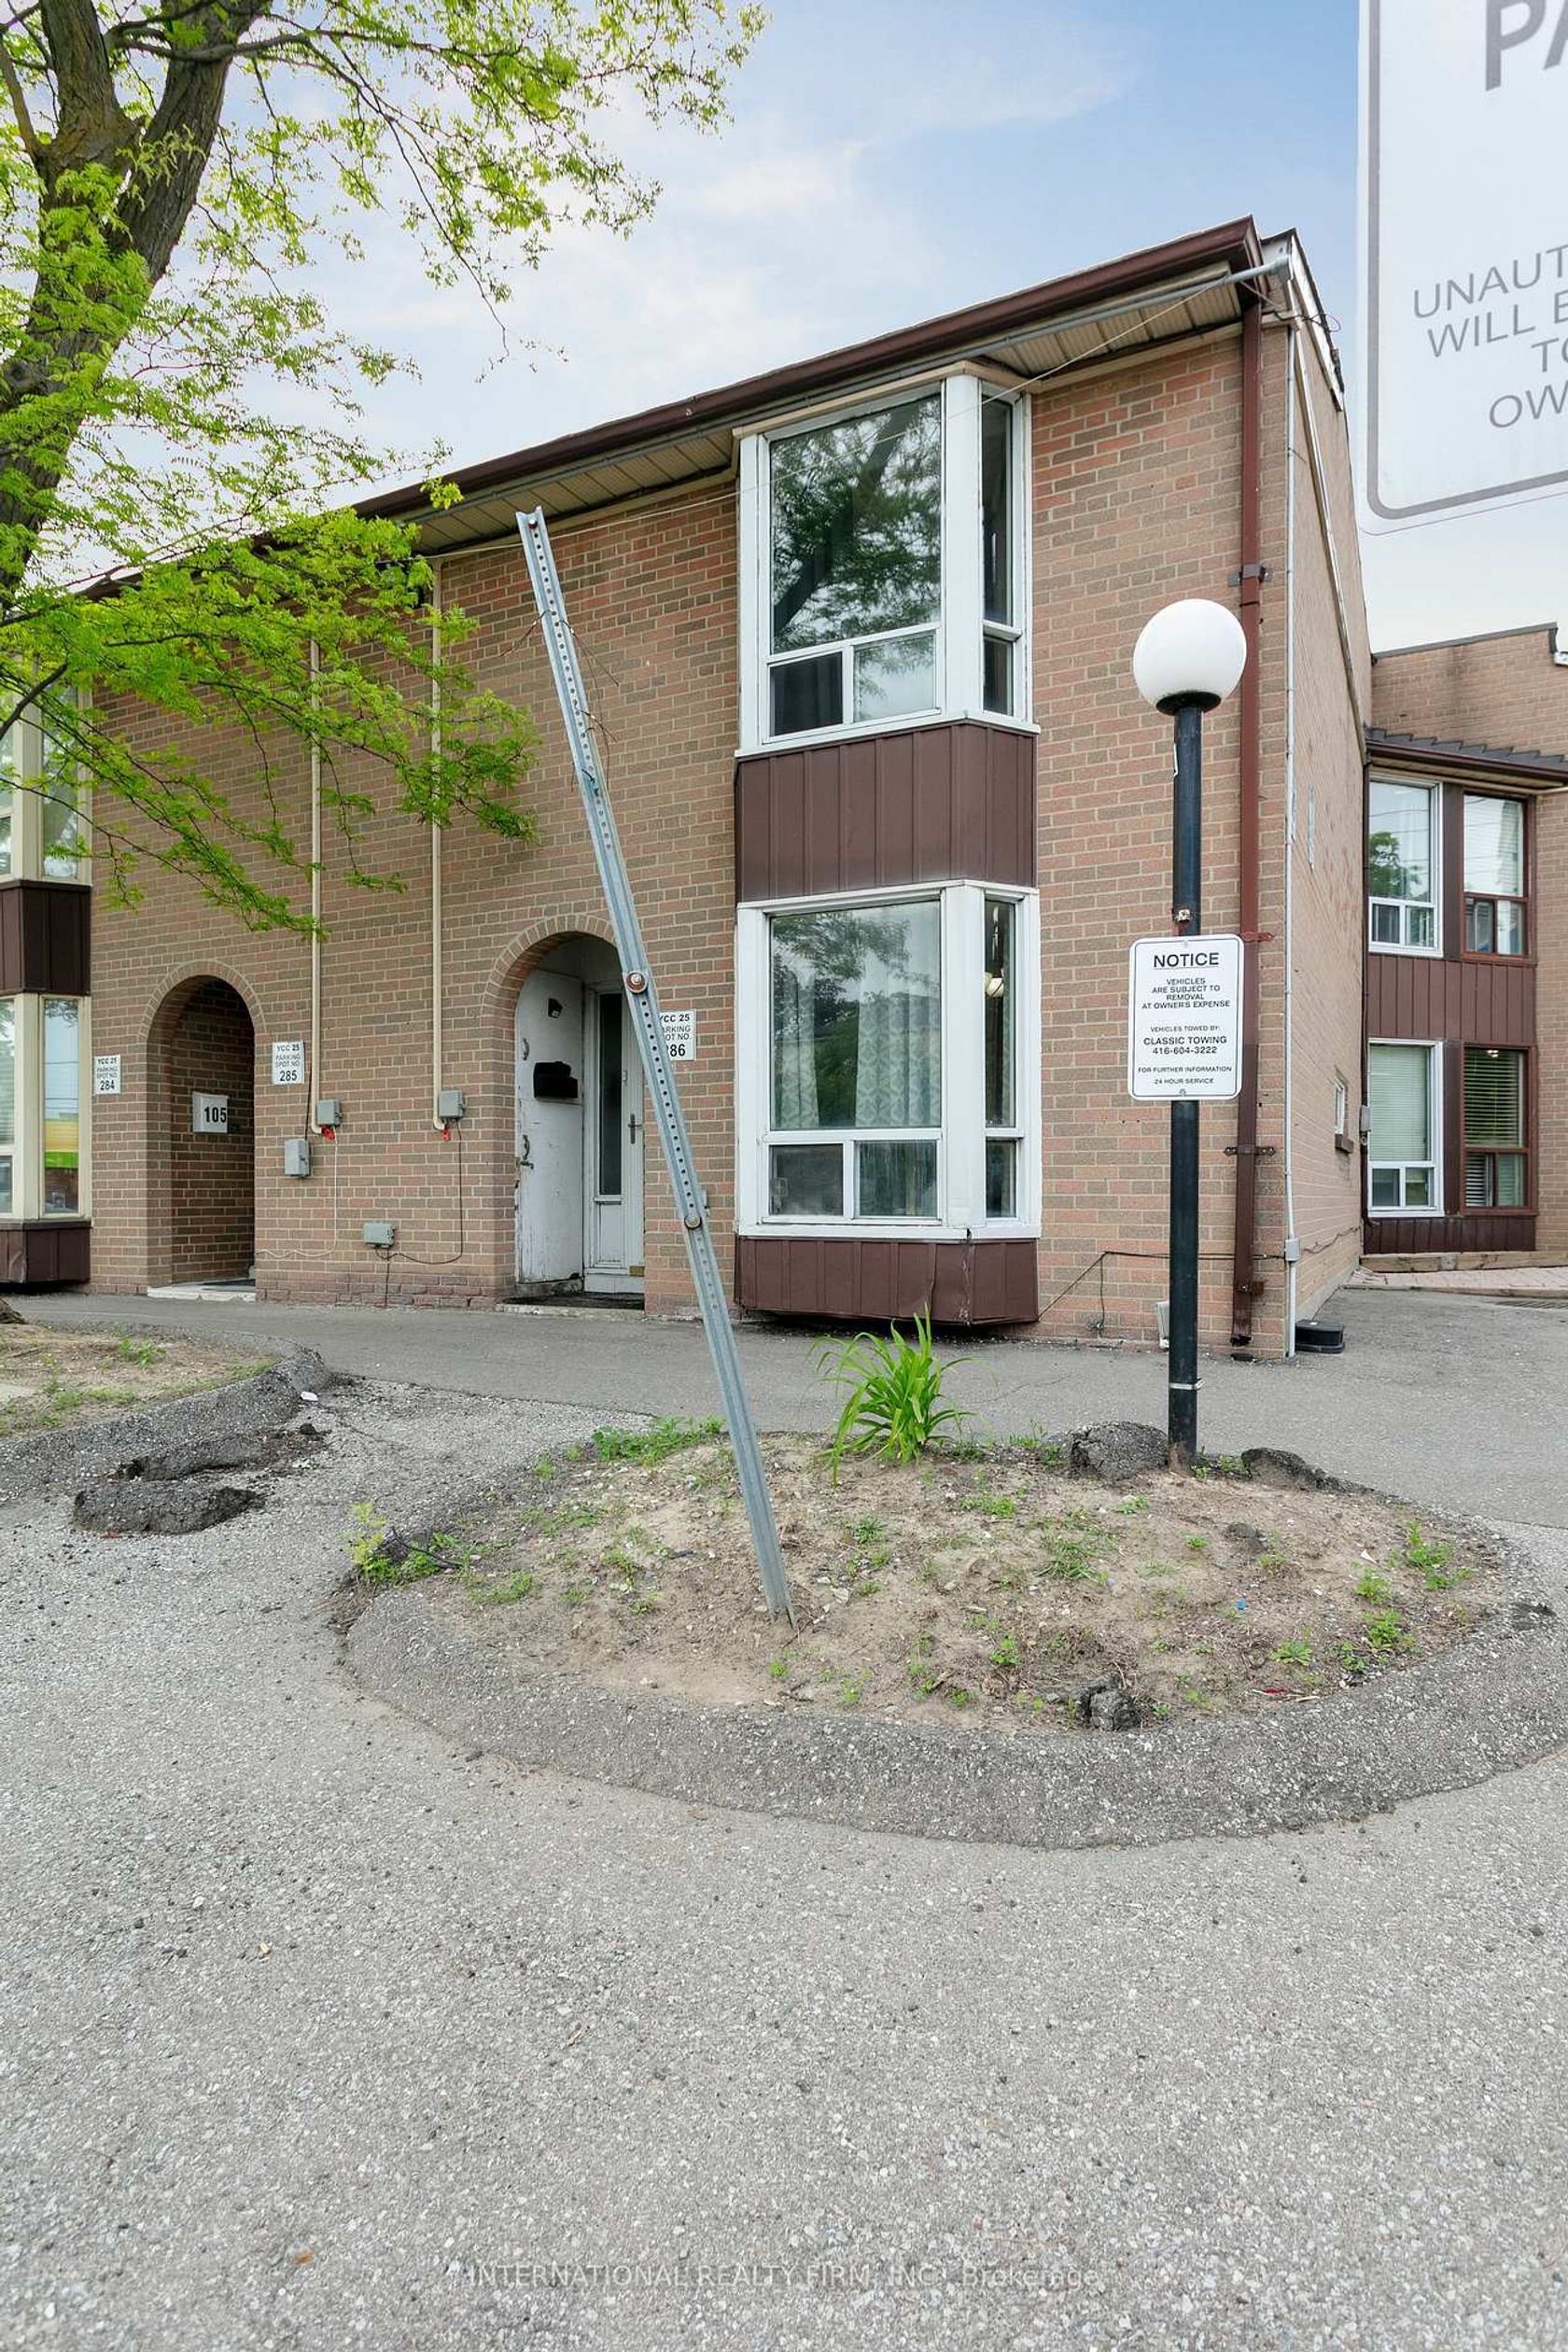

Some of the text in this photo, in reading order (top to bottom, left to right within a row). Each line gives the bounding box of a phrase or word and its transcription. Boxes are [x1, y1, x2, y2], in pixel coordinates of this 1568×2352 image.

[1414, 244, 1568, 318] UNAUT
[1427, 304, 1536, 357] WILL
[1154, 952, 1219, 968] NOTICE
[1166, 977, 1206, 986] VEHICLES
[1152, 986, 1168, 994] ARE
[1169, 985, 1208, 994] SUBJECT
[1166, 993, 1205, 1001] REMOVAL
[1193, 1000, 1231, 1008] EXPENSE
[679, 1014, 690, 1022] 25
[1143, 1035, 1227, 1045] CLASSIC TOWING
[667, 1044, 686, 1057] 86
[1153, 1045, 1218, 1055] 416-604-3222
[280, 1070, 298, 1082] 285
[100, 1079, 115, 1091] 284
[204, 1106, 227, 1123] 105
